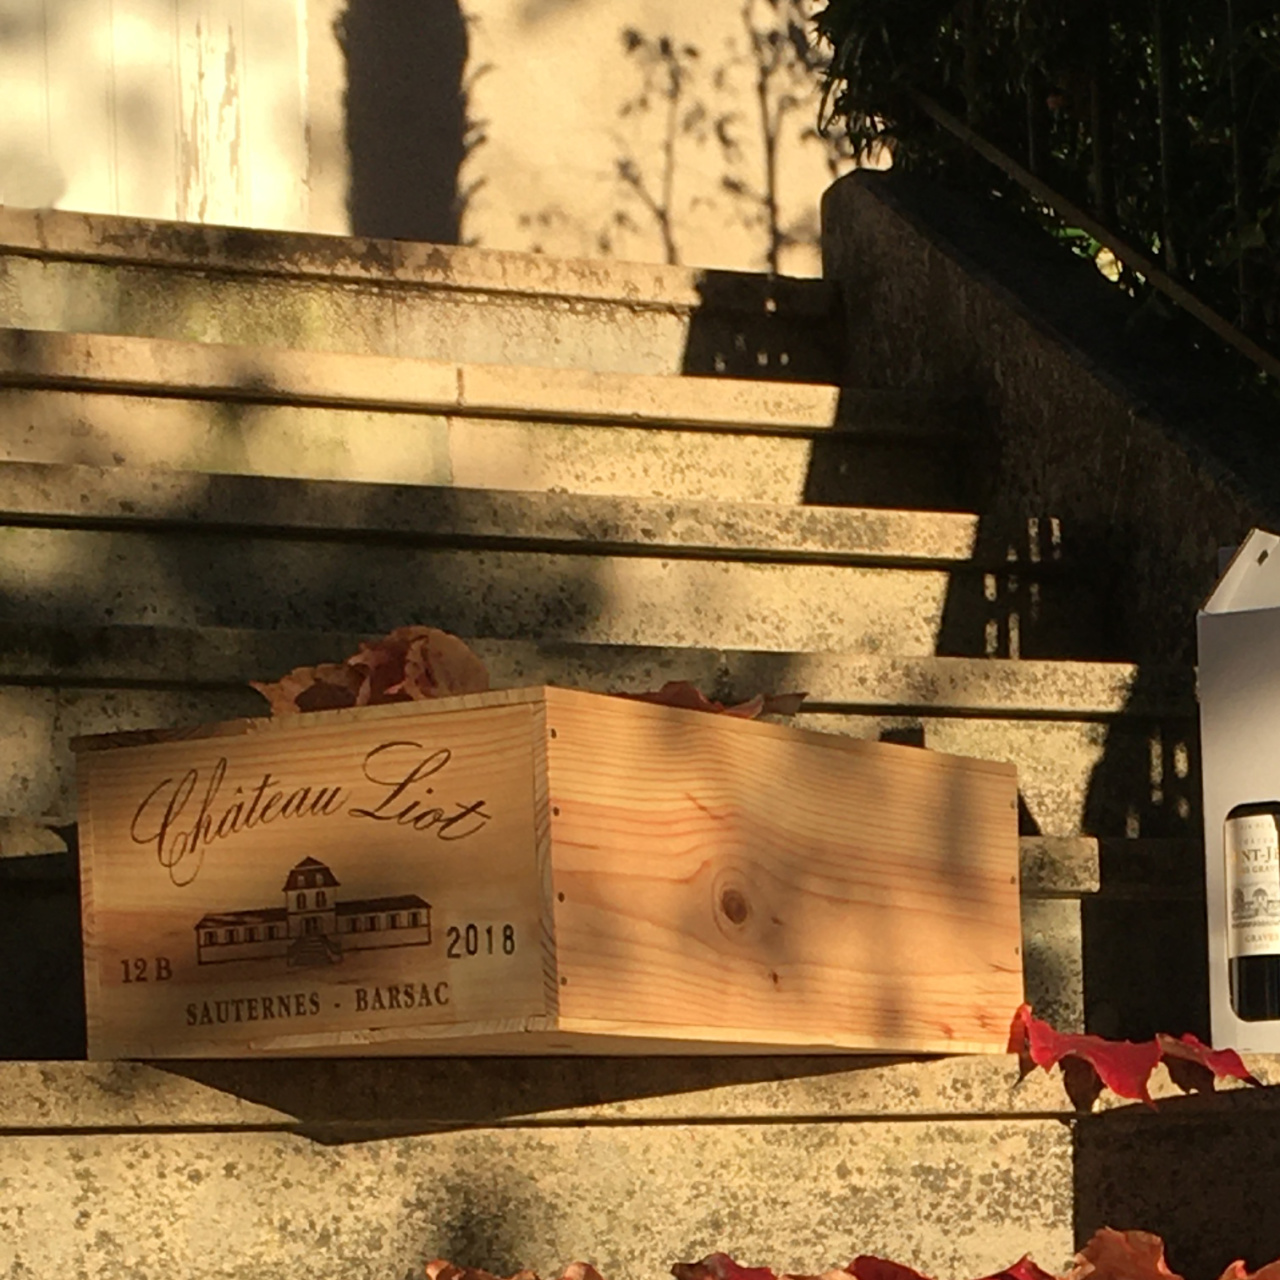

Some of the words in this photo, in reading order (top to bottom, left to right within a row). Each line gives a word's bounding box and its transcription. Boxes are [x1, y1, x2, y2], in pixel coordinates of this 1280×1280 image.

[130, 756, 350, 887] Château
[348, 741, 492, 841] Liot
[446, 923, 517, 960] 2018
[120, 957, 148, 984] 12
[155, 956, 173, 981] B
[186, 992, 321, 1027] SAUTERNES
[355, 981, 451, 1014] BARSAC
